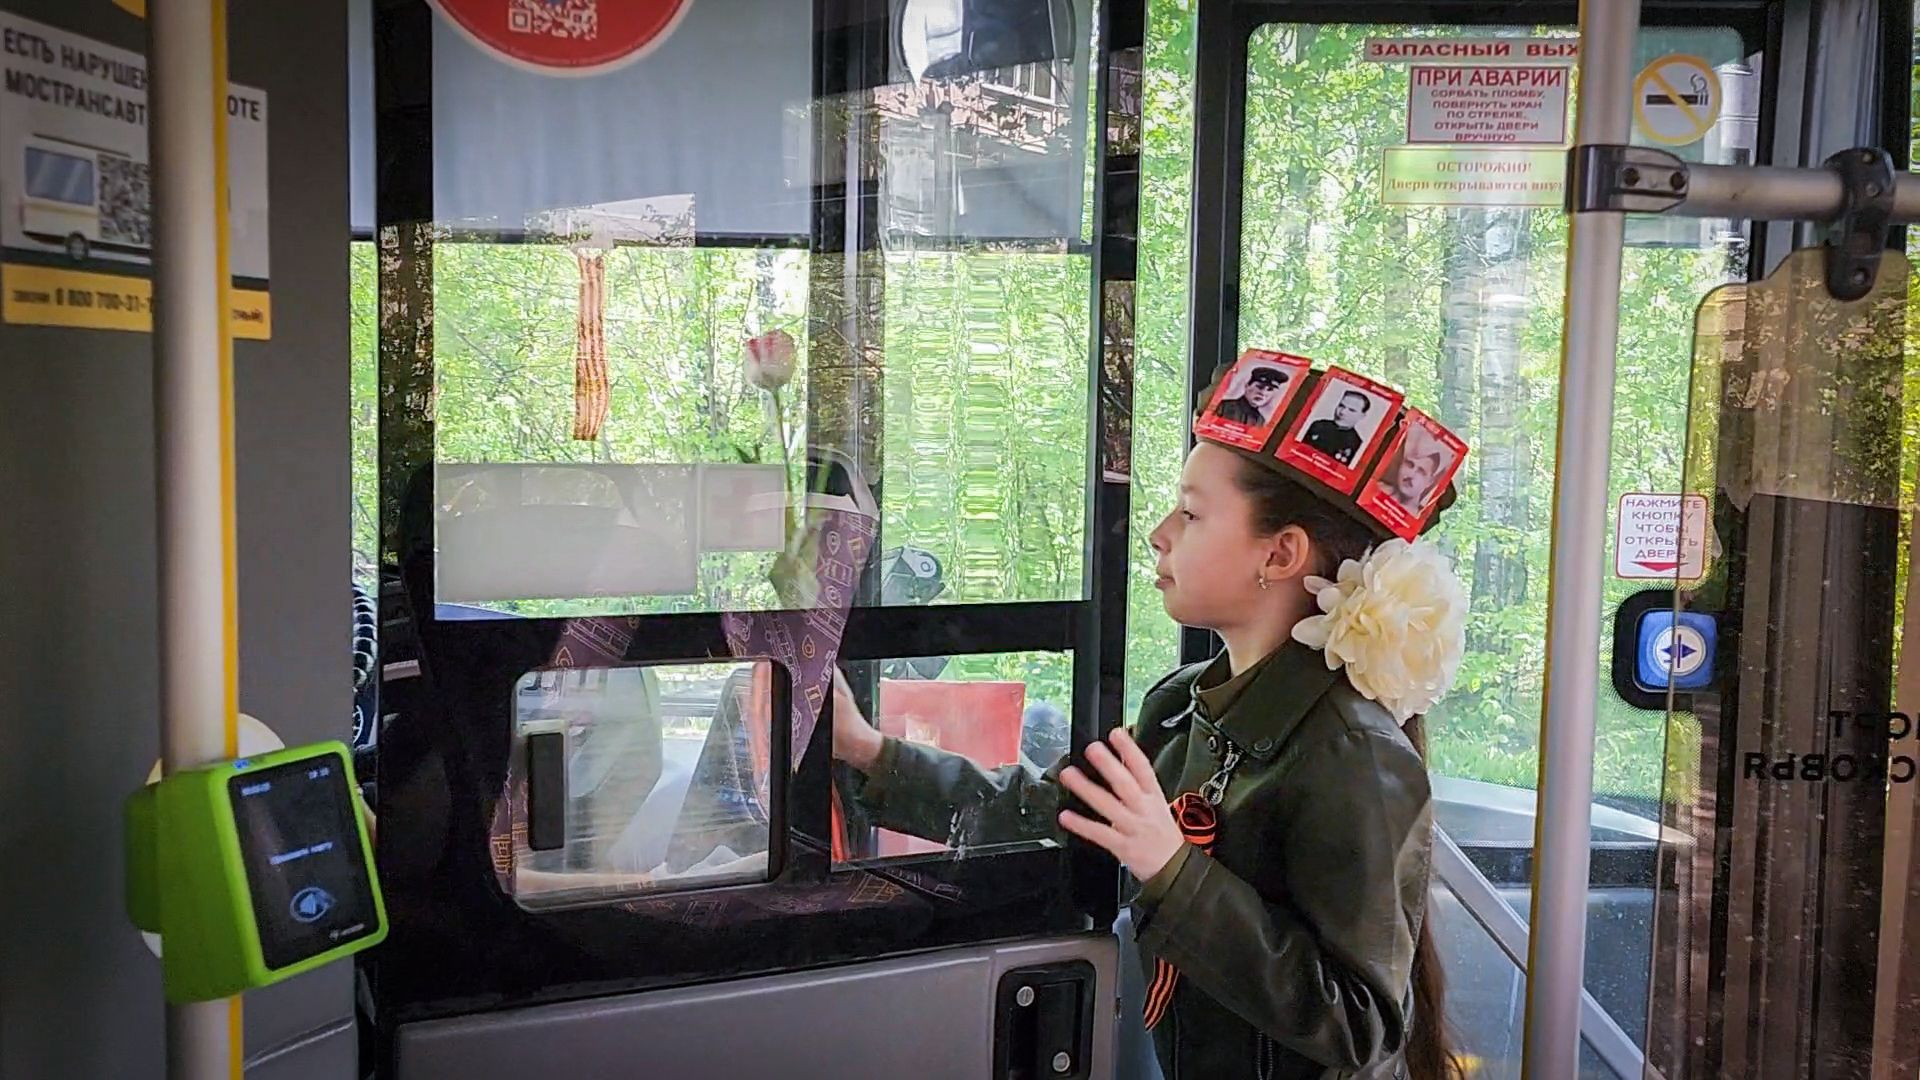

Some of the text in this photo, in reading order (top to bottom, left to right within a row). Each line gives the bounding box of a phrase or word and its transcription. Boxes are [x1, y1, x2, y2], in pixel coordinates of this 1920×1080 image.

[4, 28, 55, 64] ЕСТЬ
[1370, 42, 1511, 57] ЗАПАСНЫЙ
[1417, 69, 1561, 87] ПРИ АВАРИИ
[1431, 89, 1488, 98] СОРВАТЬ
[1433, 101, 1542, 109] ПОВЕРНУТЬ КРАН
[1446, 110, 1465, 119] ПО
[1434, 121, 1539, 131] ОТКРЫТЬ ДВЕРИ
[1455, 133, 1516, 141] ВРУЧНУЮ
[1436, 161, 1532, 173] ОСТОРОЖНО!
[1386, 179, 1429, 192] Двери
[1434, 179, 1527, 193] открываются
[1625, 499, 1702, 509] НАЖМИТЕ
[1624, 536, 1698, 547] ОТКРЫТЬ
[1635, 549, 1686, 559] ДВЕРЬ
